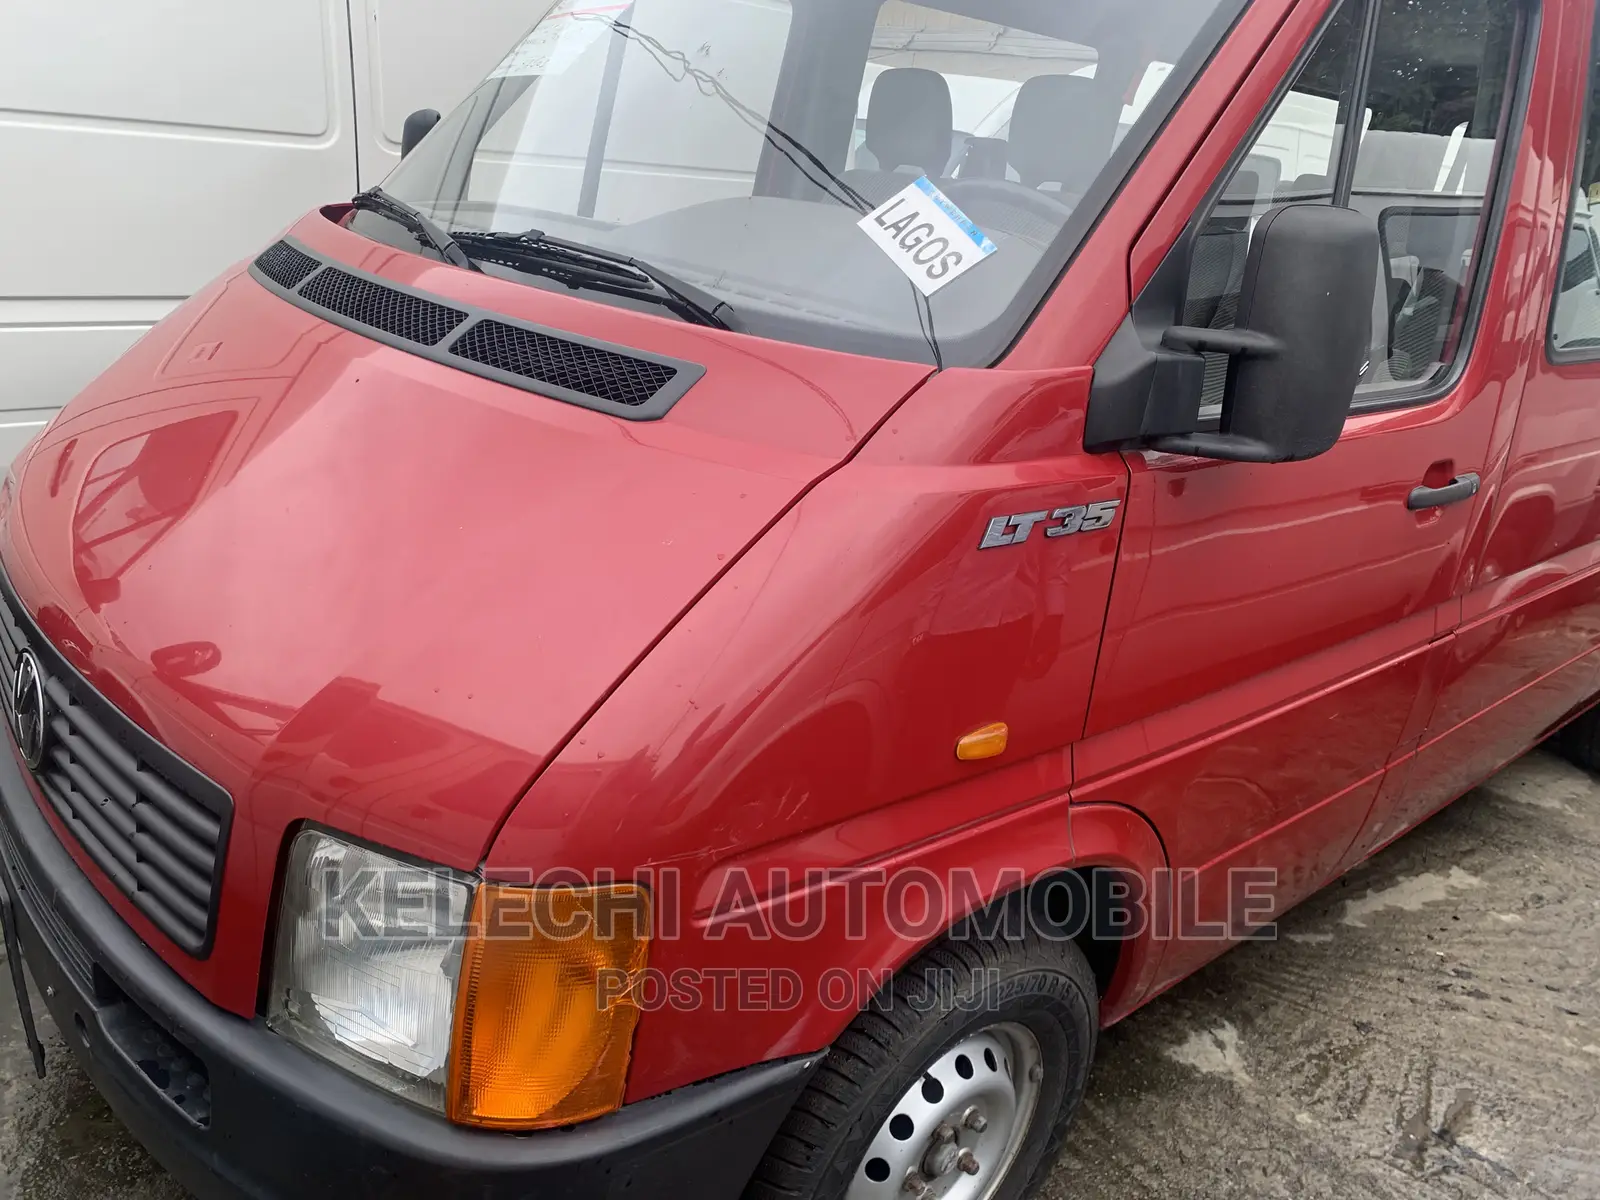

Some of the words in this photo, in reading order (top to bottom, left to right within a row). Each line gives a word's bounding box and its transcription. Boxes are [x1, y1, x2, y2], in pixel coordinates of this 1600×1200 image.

[874, 198, 963, 280] LAGOS
[978, 510, 1049, 550] LT
[1045, 499, 1121, 537] 35
